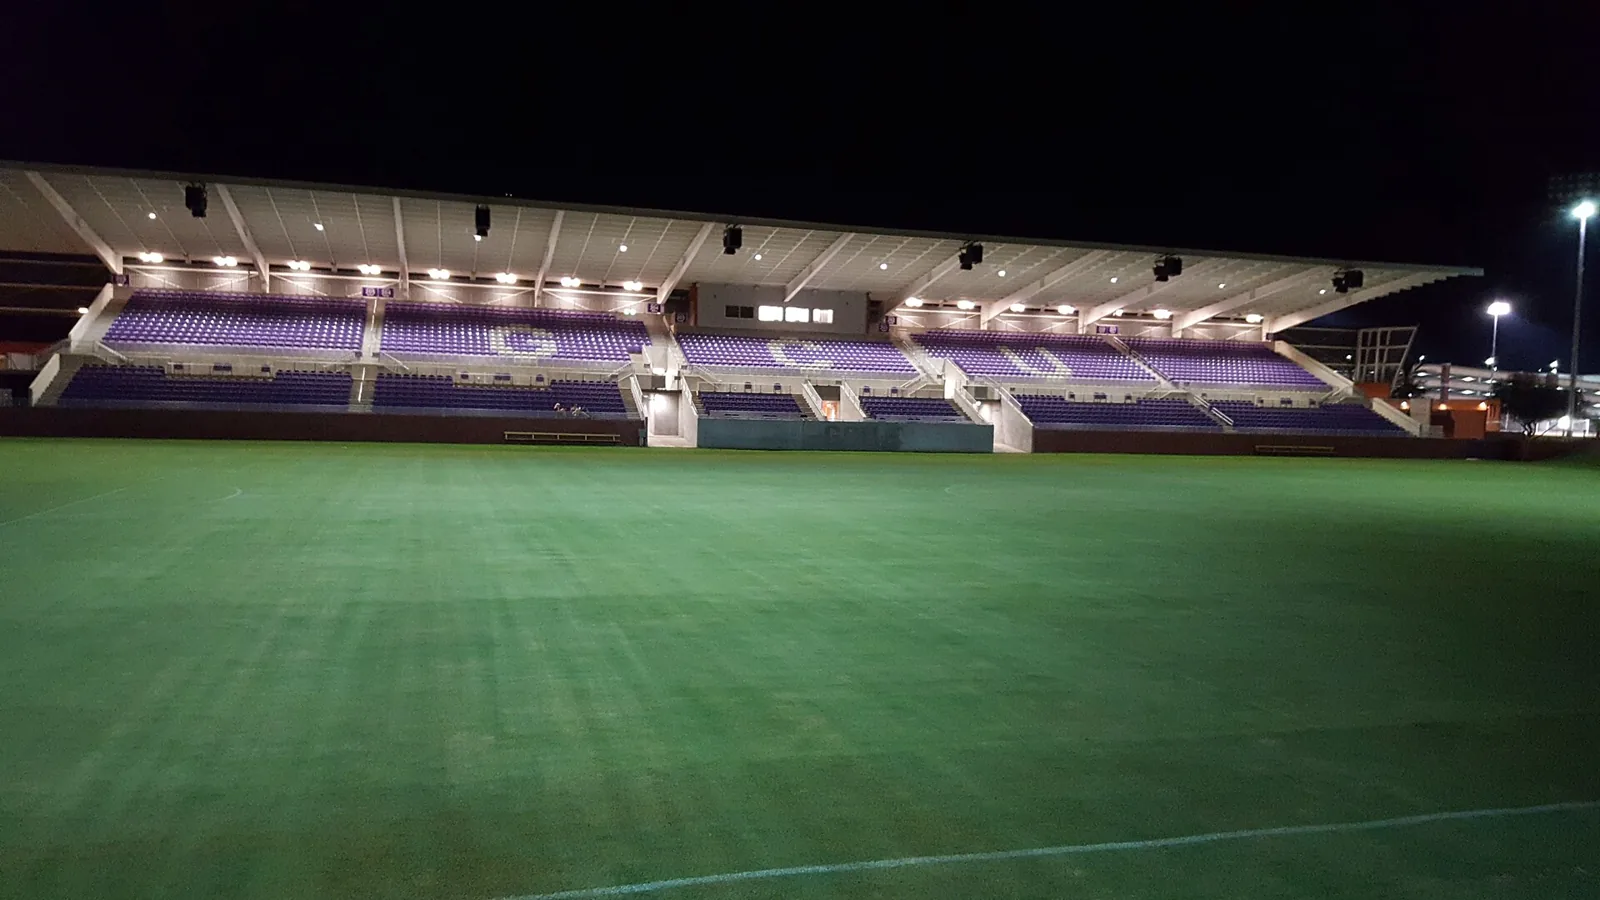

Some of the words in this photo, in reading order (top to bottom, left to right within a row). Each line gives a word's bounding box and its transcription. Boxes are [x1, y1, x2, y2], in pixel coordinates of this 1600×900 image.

[489, 323, 558, 359] G
[766, 336, 835, 372] C
[997, 345, 1073, 379] U
